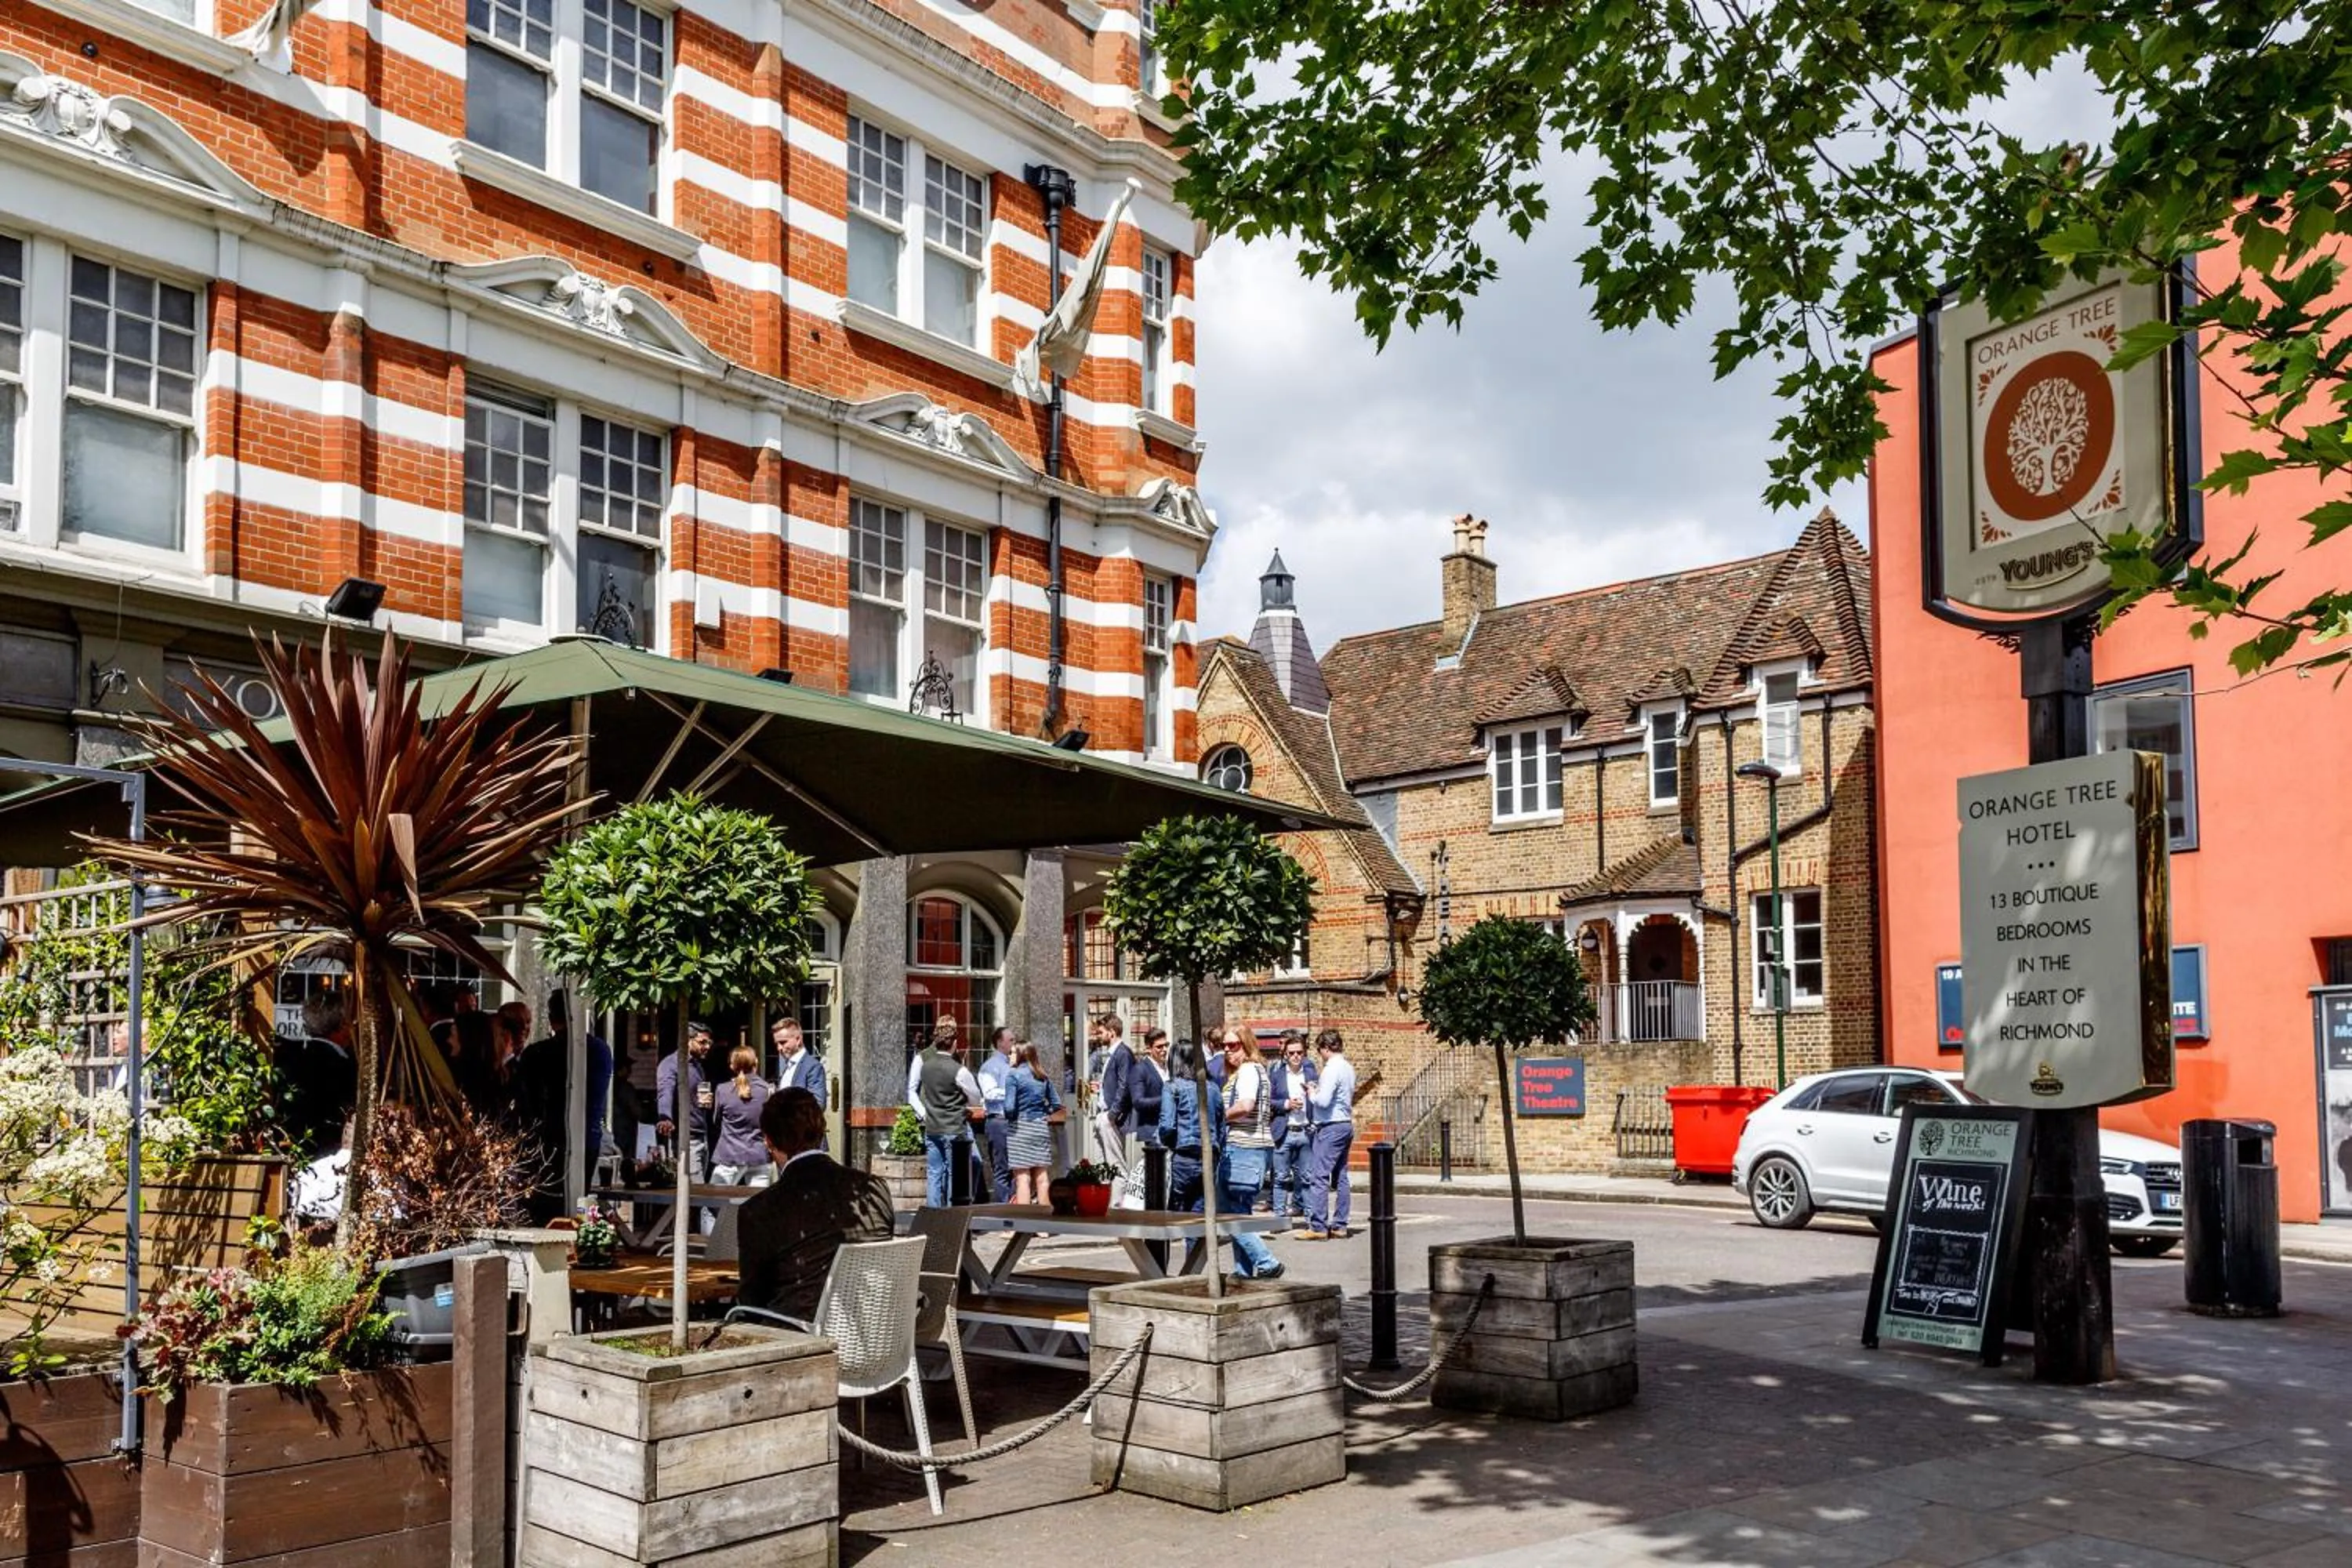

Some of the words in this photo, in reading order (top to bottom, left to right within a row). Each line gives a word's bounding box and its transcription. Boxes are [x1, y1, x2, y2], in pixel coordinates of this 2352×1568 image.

[1978, 318, 2060, 365] ORANGE
[2067, 296, 2115, 330] TREE
[2000, 541, 2095, 582] YOUNG'S
[1969, 789, 2057, 819] ORANGE
[2065, 780, 2118, 804] TREE
[2006, 820, 2076, 846] HOTEL
[1991, 893, 2006, 909] 13
[2013, 883, 2100, 907] BOUTIQUE
[1997, 918, 2092, 942] BEDROOMS
[2017, 957, 2034, 973] IN
[2039, 955, 2071, 972] THE
[2006, 989, 2057, 1007] HEART
[2062, 988, 2085, 1005] OF
[2000, 1022, 2094, 1041] RICHMOND
[1523, 1065, 1573, 1079] Orange
[1523, 1080, 1553, 1093] Tree
[1523, 1095, 1578, 1109] Theatre
[1951, 1122, 2012, 1137] ORANGE
[1949, 1134, 1982, 1149] TREE
[1918, 1174, 1983, 1203] Wine
